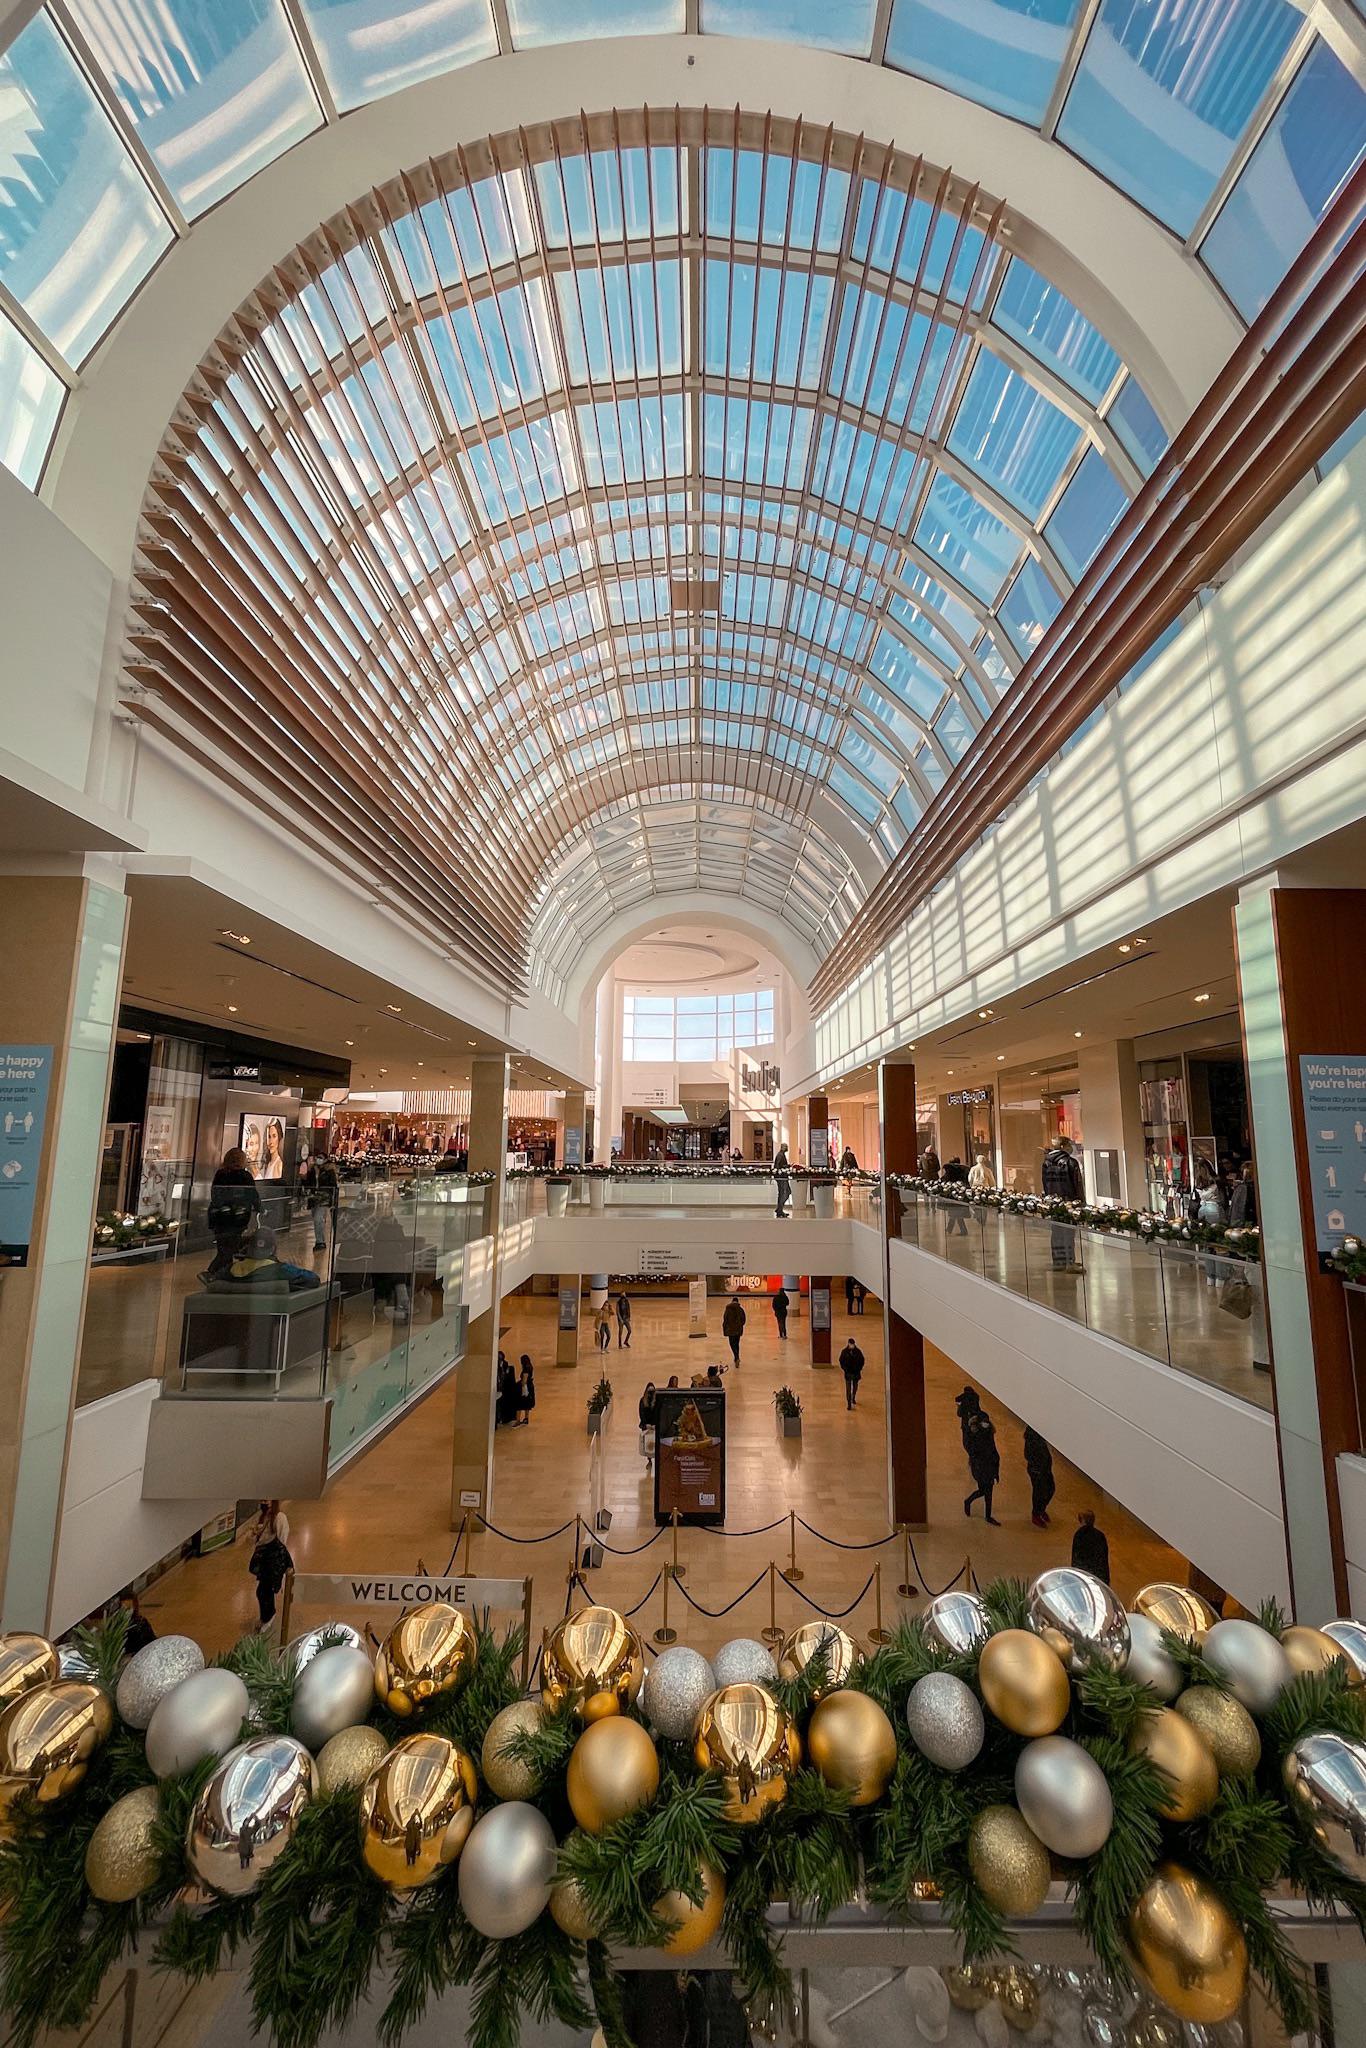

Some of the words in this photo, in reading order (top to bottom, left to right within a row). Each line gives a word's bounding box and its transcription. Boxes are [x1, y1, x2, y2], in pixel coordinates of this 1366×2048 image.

[6, 1054, 45, 1068] happy
[7, 1068, 36, 1079] here
[1306, 1064, 1341, 1076] We're
[1308, 1077, 1346, 1090] you're
[730, 1274, 761, 1289] Indigo
[351, 1582, 467, 1604] WELCOME
